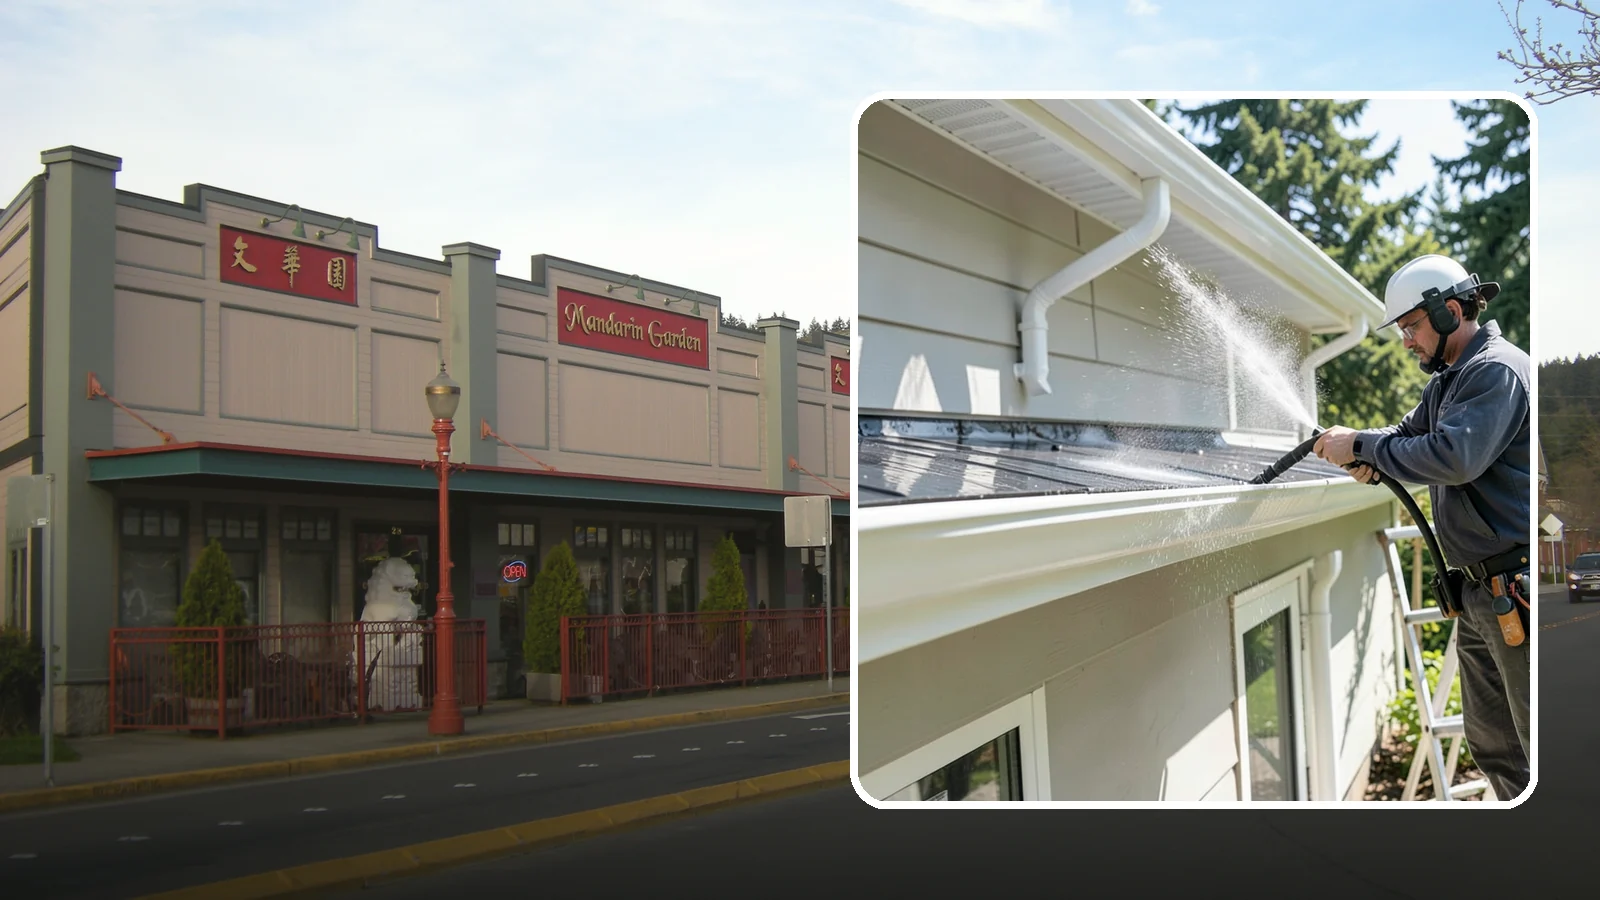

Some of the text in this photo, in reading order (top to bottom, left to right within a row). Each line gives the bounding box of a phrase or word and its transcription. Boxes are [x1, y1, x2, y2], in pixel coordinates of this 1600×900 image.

[230, 235, 346, 290] 文華園
[564, 302, 702, 352] Mandarin Garden
[503, 565, 527, 578] OPEN
